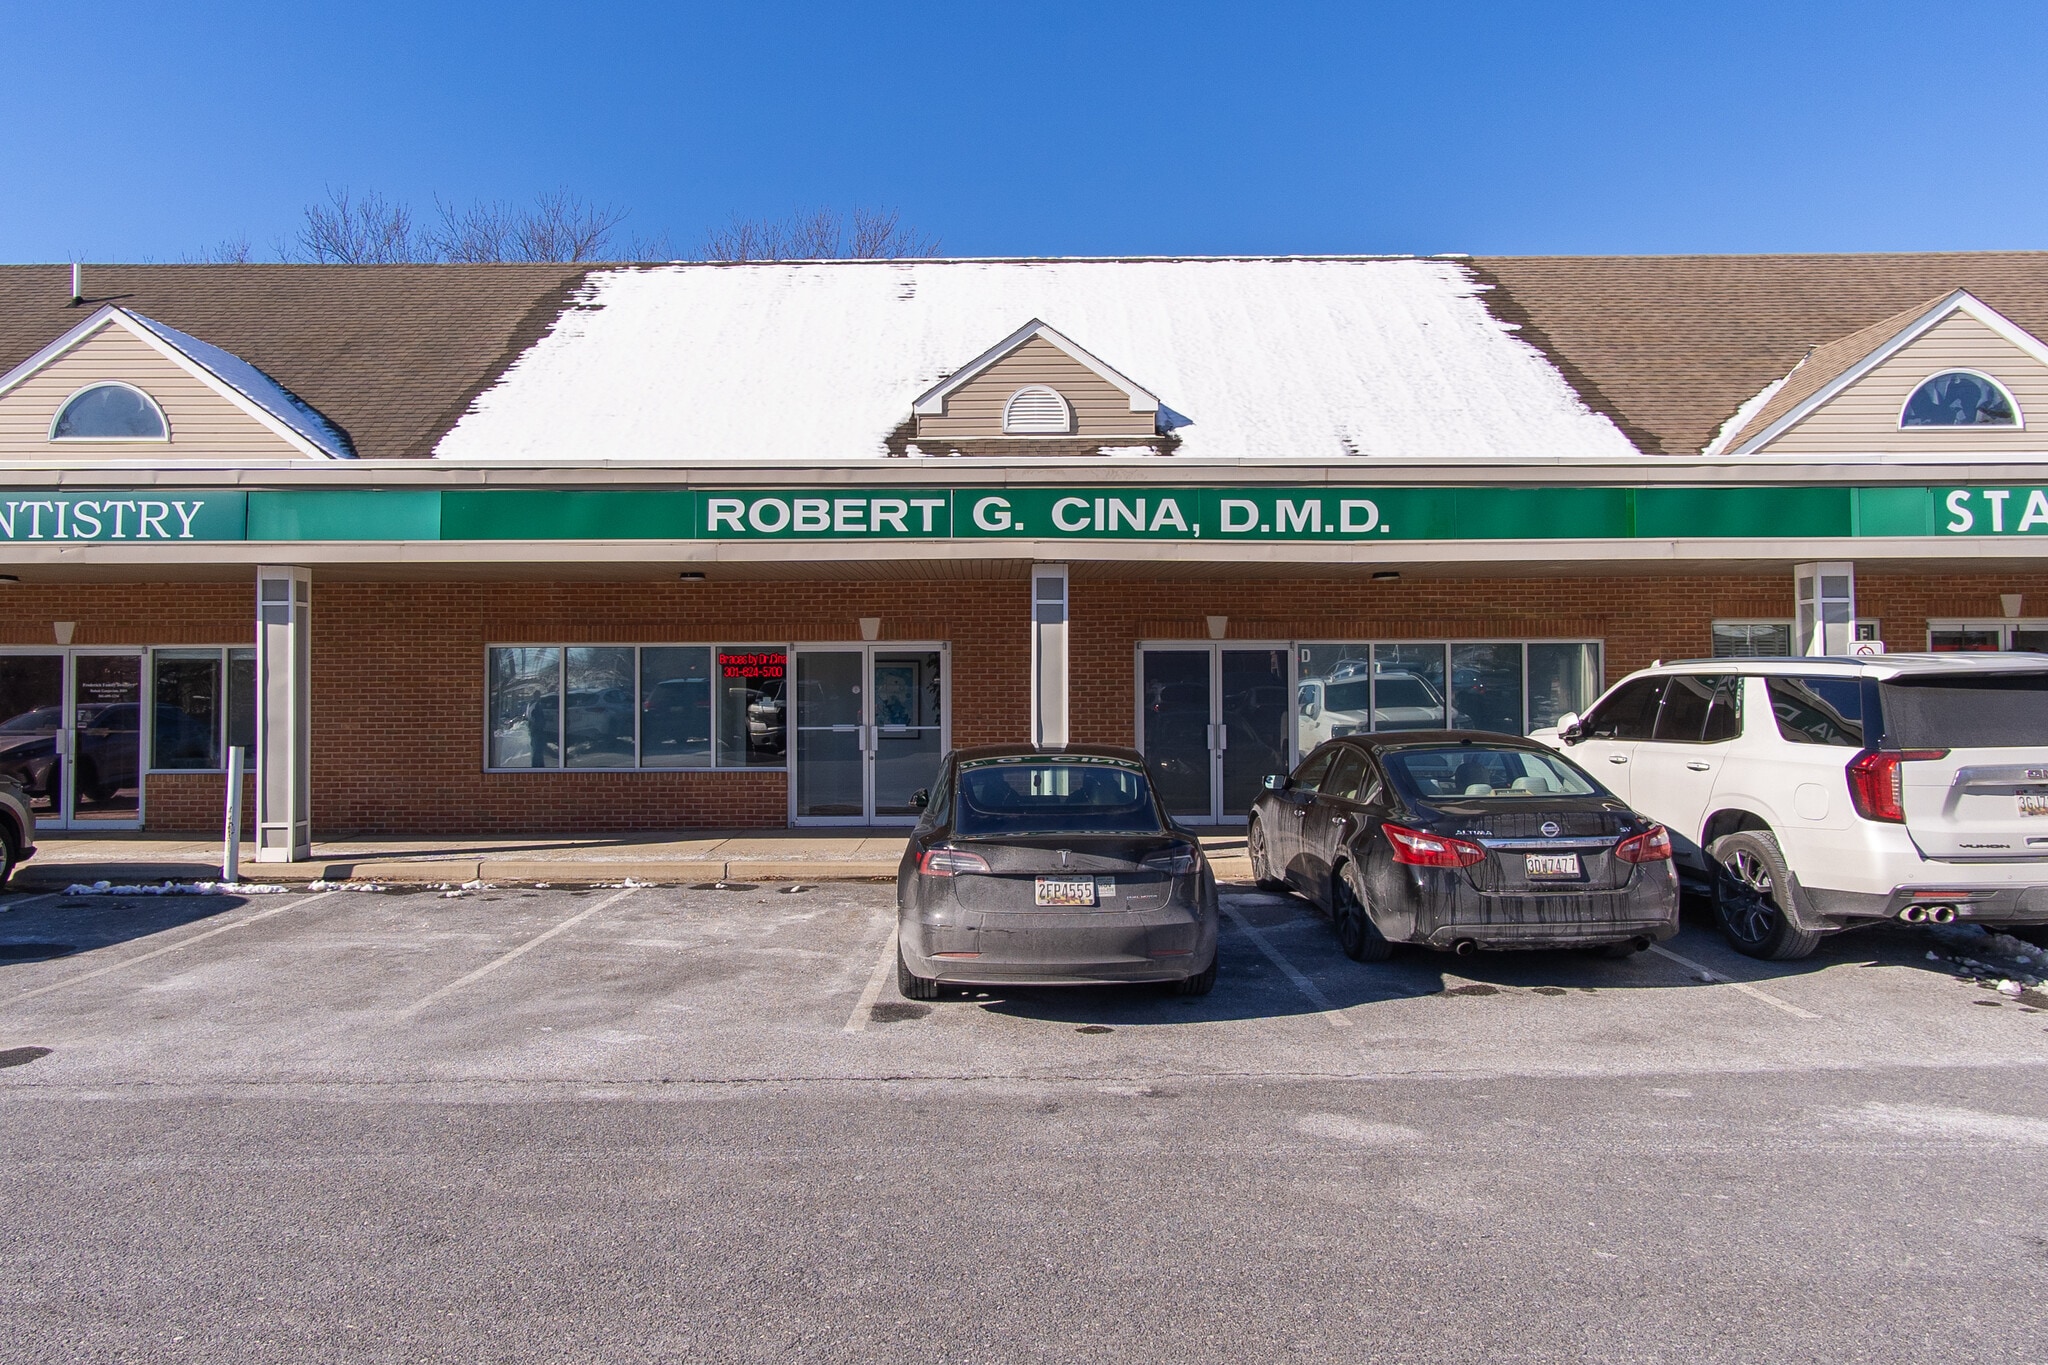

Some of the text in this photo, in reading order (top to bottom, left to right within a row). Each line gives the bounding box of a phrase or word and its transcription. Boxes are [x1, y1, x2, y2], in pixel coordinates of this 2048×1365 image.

[707, 497, 1390, 538] ROBERT G. CINA, D.M.D.
[1946, 490, 2048, 533] STA
[719, 653, 747, 665] Braces
[748, 652, 757, 667] by
[1301, 649, 1311, 663] D
[724, 666, 783, 678] 301-624-5700
